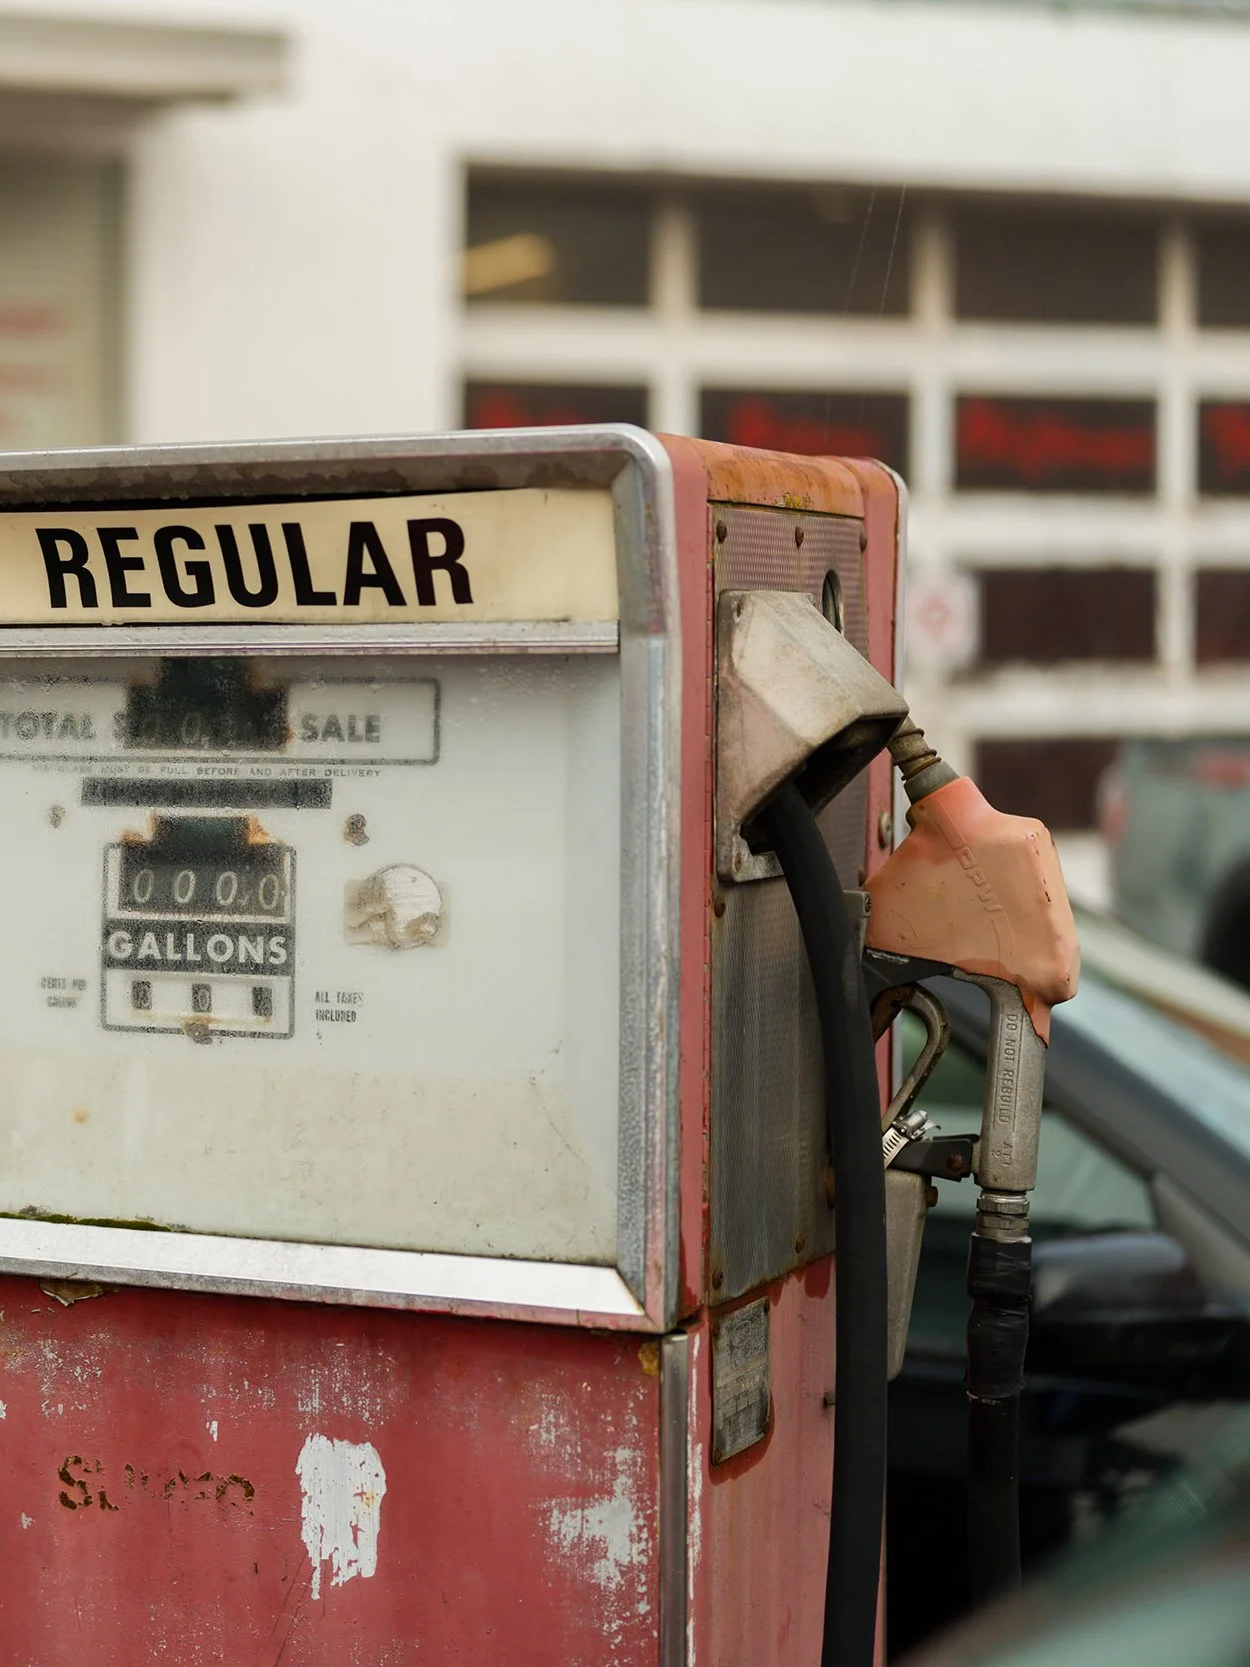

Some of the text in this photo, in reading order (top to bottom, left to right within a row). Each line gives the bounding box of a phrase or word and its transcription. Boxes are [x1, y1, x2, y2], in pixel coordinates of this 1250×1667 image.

[35, 517, 474, 609] REGULAR
[300, 713, 381, 744] SALE
[160, 766, 188, 775] FULL
[250, 767, 272, 776] AND
[280, 768, 316, 777] AFTER
[324, 768, 381, 778] DELIVERY
[107, 930, 288, 965] GALLONS
[315, 991, 364, 1005] ALL TAXES
[315, 1009, 357, 1023] INCLUDED
[998, 1013, 1019, 1123] DO NOT REBUILD
